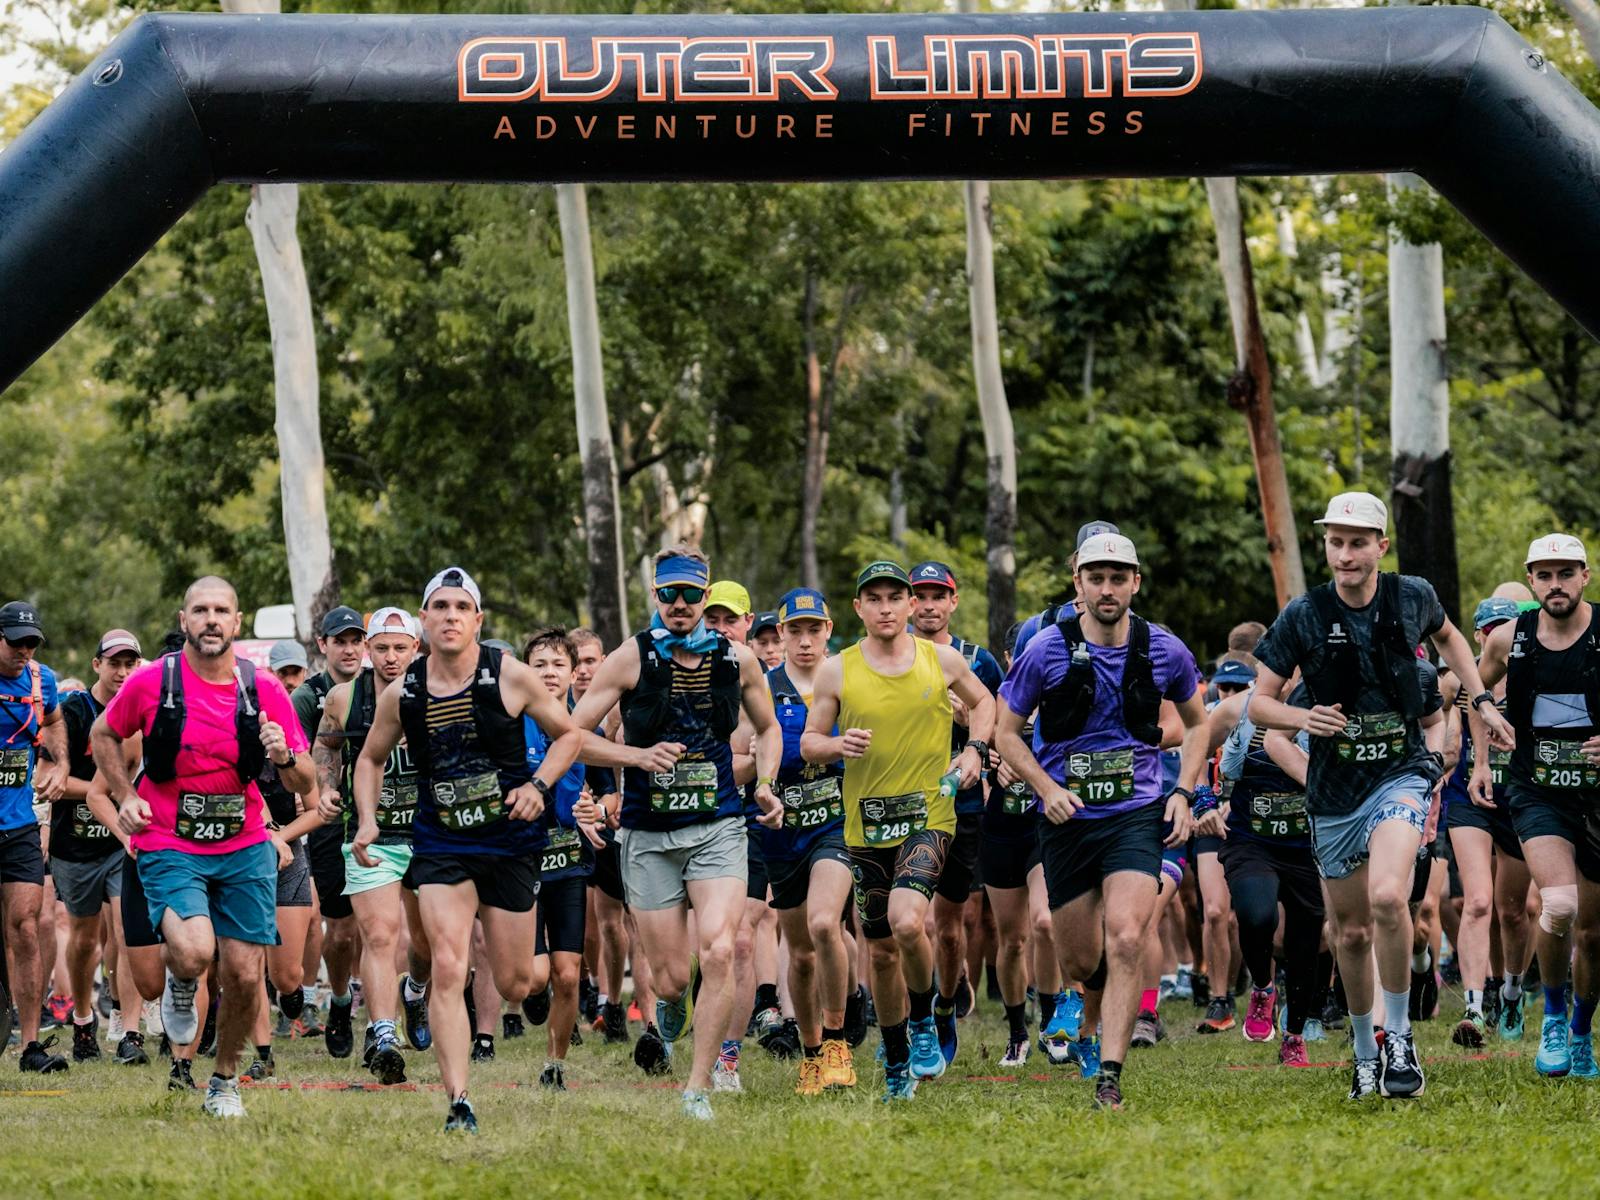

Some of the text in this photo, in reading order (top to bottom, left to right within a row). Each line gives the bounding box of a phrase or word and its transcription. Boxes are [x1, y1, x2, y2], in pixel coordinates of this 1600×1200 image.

[458, 36, 839, 101] OUTER
[494, 110, 1144, 139] ADVENTURE FITNESS
[1355, 742, 1388, 761] 232
[1550, 769, 1582, 787] 205
[1087, 781, 1115, 799] 179
[668, 792, 700, 810] 224
[391, 809, 415, 825] 217
[454, 805, 486, 827] 164
[800, 806, 828, 827] 229
[87, 825, 110, 838] 270
[193, 822, 226, 840] 243
[881, 822, 910, 841] 248
[1270, 820, 1288, 835] 78
[541, 853, 567, 872] 220
